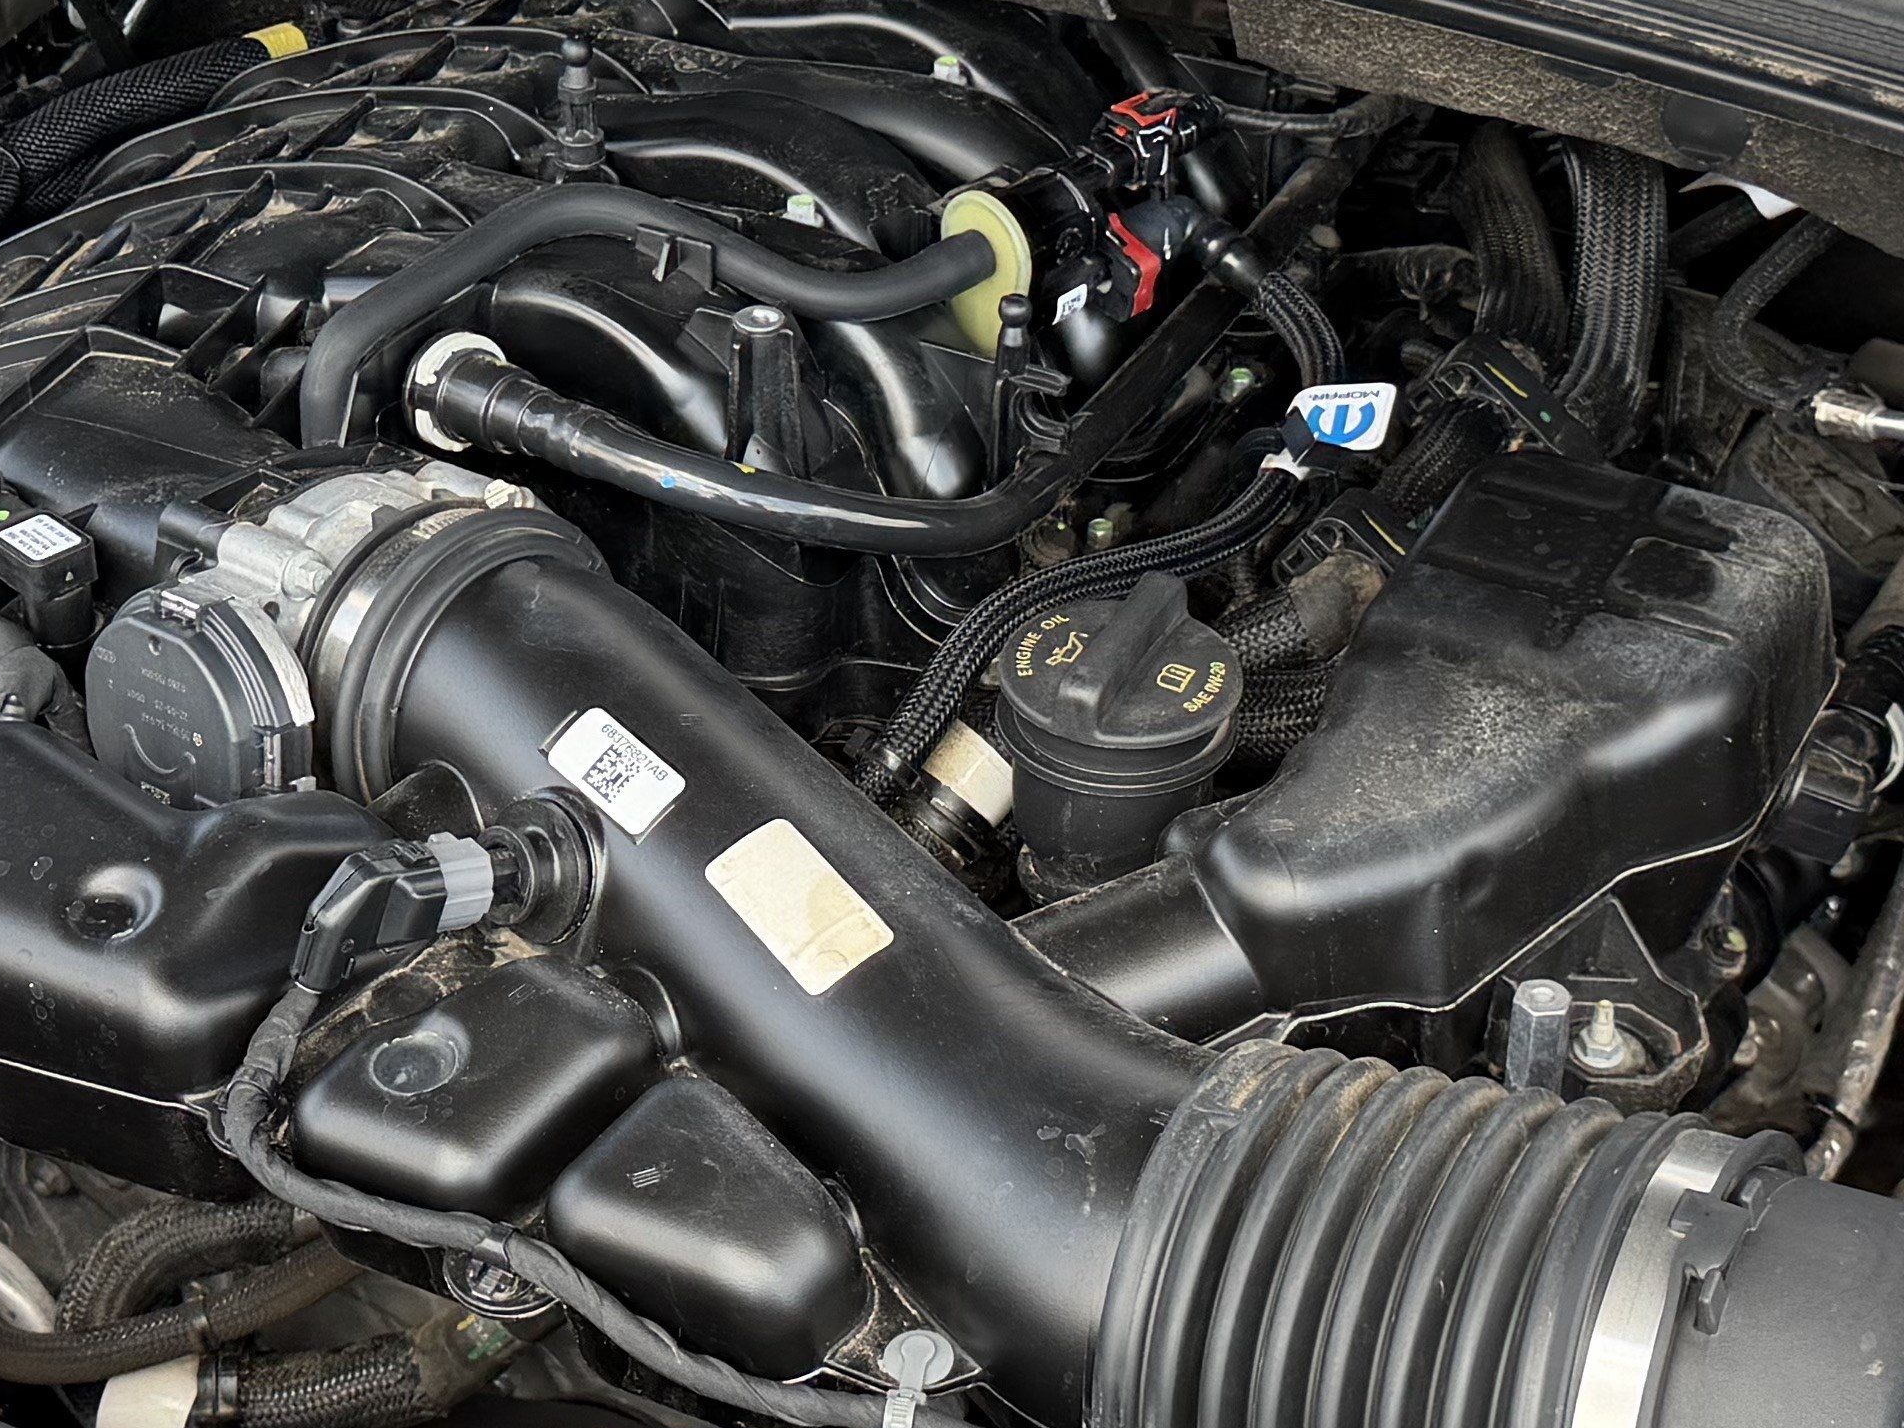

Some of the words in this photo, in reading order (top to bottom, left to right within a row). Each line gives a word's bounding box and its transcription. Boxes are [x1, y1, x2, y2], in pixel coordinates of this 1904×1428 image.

[1015, 631, 1043, 677] ENGINE
[1040, 614, 1070, 630] OIL
[1183, 691, 1214, 712] SAE
